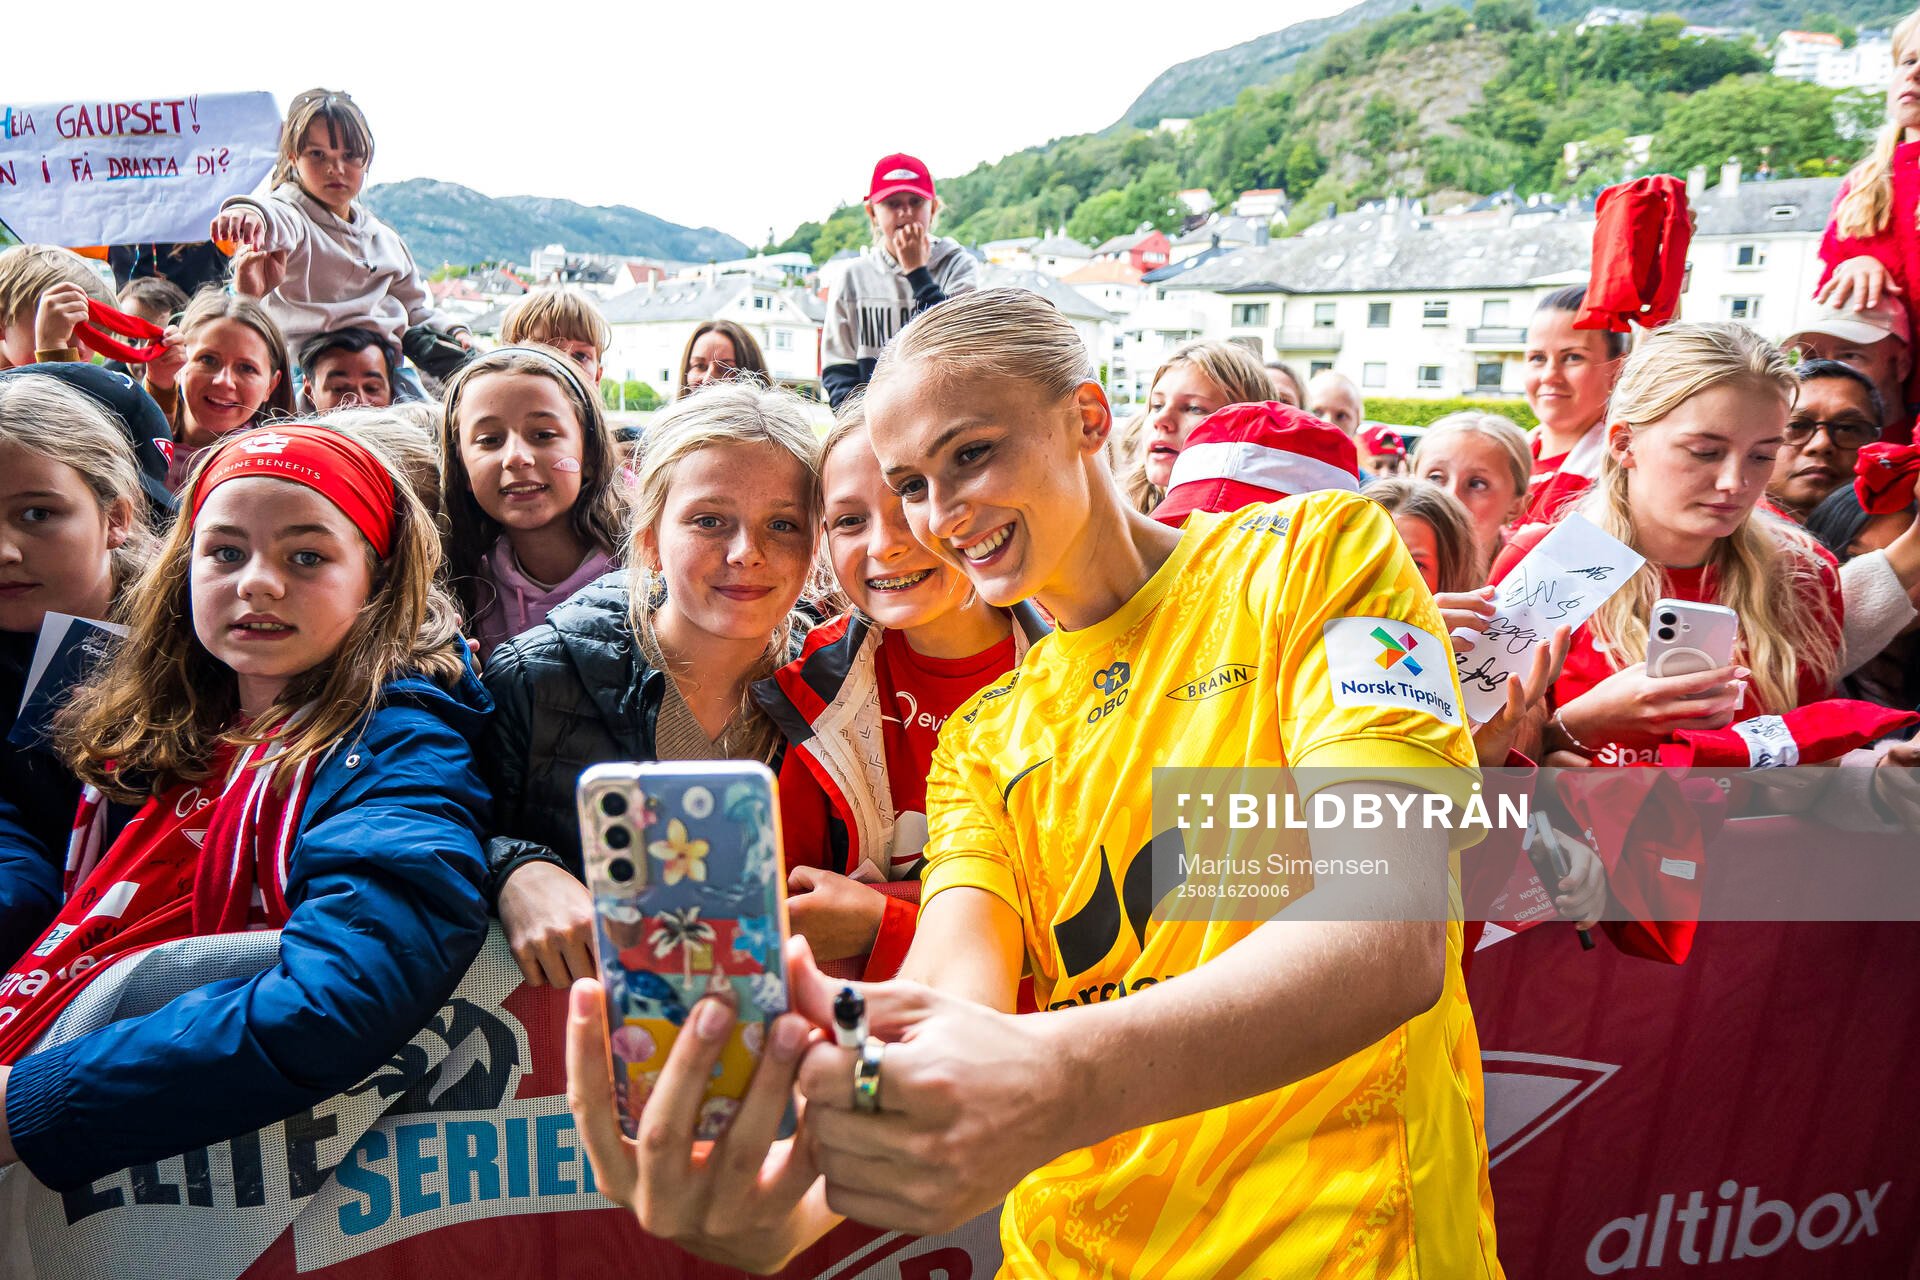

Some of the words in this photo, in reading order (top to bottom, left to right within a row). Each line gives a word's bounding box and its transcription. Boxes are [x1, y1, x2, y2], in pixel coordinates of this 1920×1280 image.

[56, 93, 200, 138] GAUPSET!
[108, 156, 179, 178] DRAKTA
[256, 458, 321, 480] BENEFITS
[1187, 667, 1249, 698] BRANN
[1341, 680, 1397, 696] Norsk
[1398, 682, 1453, 717] Tipping
[1087, 688, 1129, 724] OBO
[1519, 886, 1546, 901] NORA
[334, 1112, 602, 1236] SERIE
[1584, 1179, 1892, 1276] altibox
